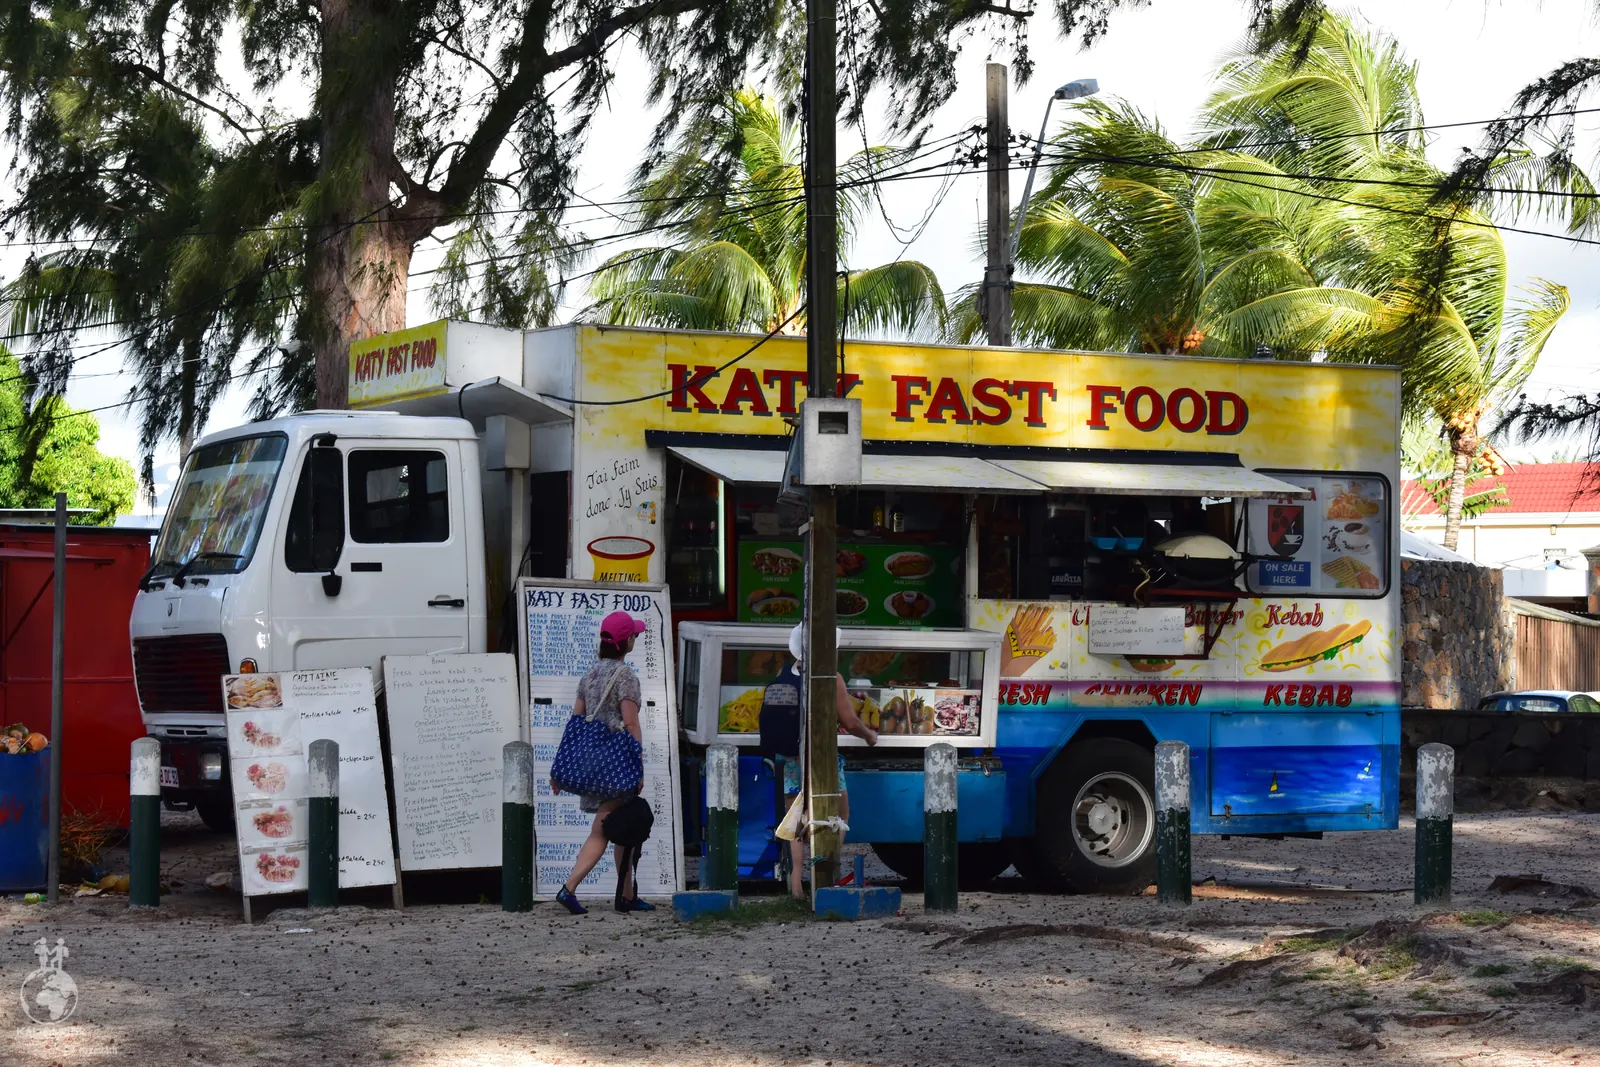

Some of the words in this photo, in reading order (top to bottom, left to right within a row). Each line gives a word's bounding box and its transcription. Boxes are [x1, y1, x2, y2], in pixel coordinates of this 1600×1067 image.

[354, 347, 385, 385] KATY
[386, 343, 411, 378] FAST
[411, 336, 438, 373] FOOD
[891, 374, 1058, 427] FAST
[1085, 384, 1250, 436] FOOD
[1051, 573, 1082, 583] LAVAZZA
[1265, 563, 1279, 572] ON
[1281, 563, 1305, 572] SALE
[1272, 575, 1297, 584] HERE
[526, 590, 565, 608] KATY
[570, 592, 609, 610] FAST
[612, 594, 652, 612] FOOD
[1262, 602, 1324, 628] Kebab
[997, 683, 1052, 706] RESH
[1263, 683, 1353, 708] KEBAB
